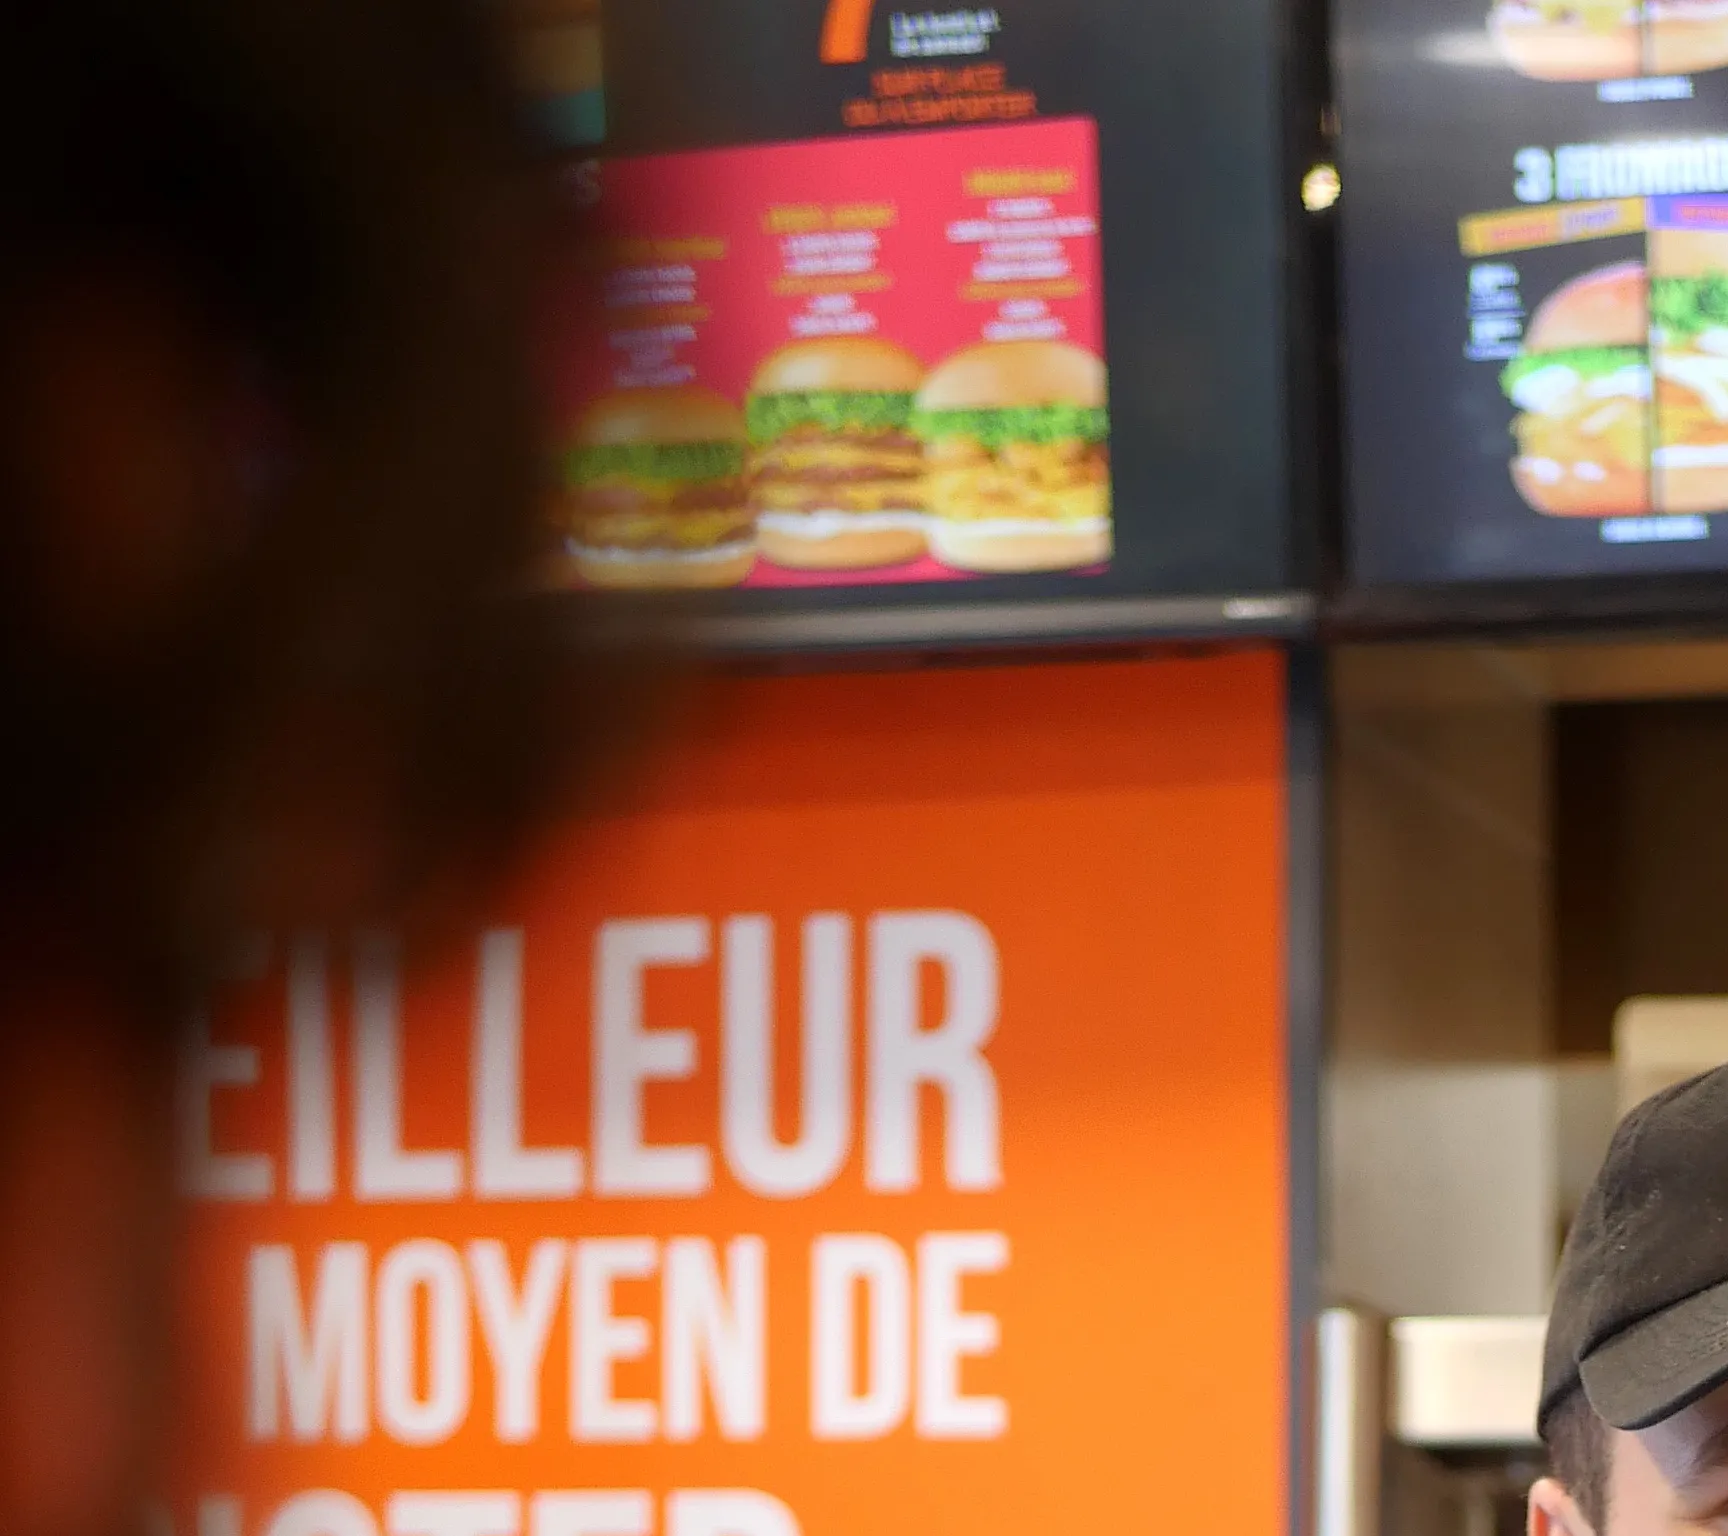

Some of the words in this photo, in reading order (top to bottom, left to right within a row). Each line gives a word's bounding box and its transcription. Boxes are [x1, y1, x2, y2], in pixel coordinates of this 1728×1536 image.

[1514, 147, 1554, 202] 3
[246, 1235, 769, 1446] MOYEN
[809, 1231, 1010, 1442] DE
